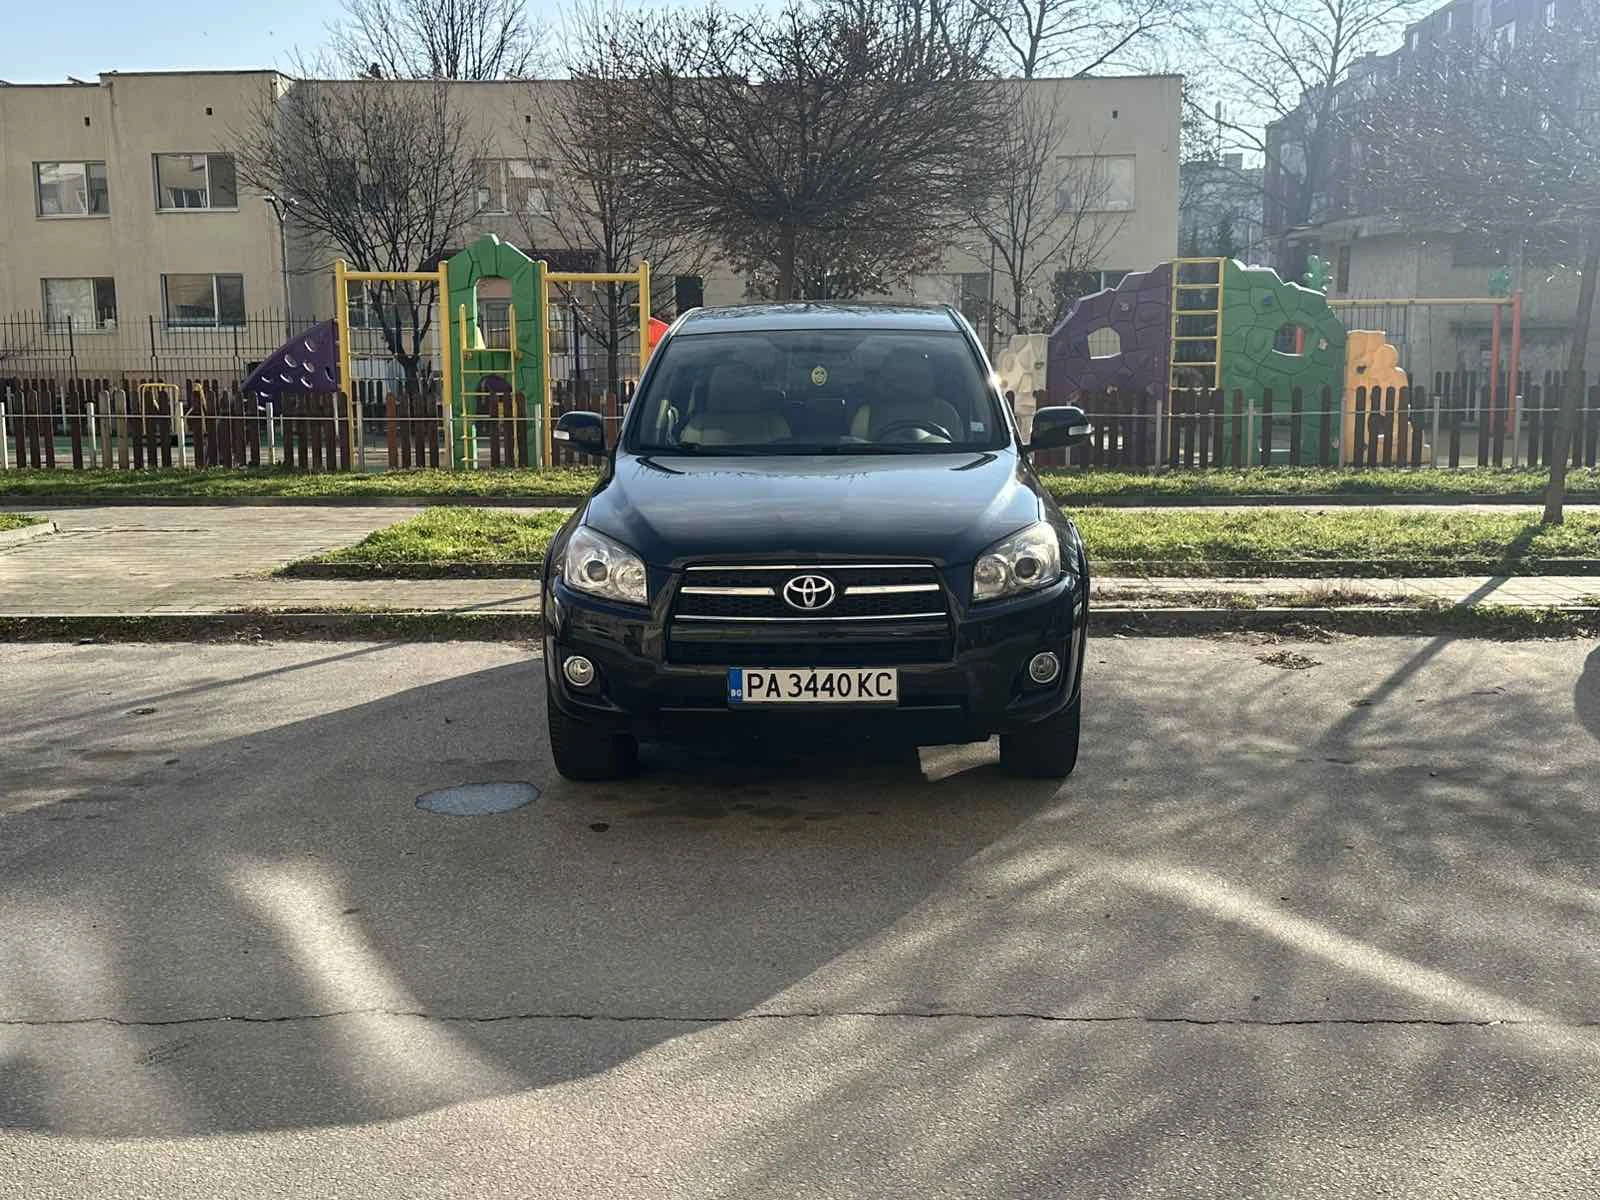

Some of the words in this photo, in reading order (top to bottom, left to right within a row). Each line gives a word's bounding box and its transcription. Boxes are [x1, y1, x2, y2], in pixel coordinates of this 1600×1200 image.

[730, 689, 742, 697] BG
[747, 673, 781, 698] PA
[787, 673, 852, 698] 3440
[858, 672, 892, 697] KC
